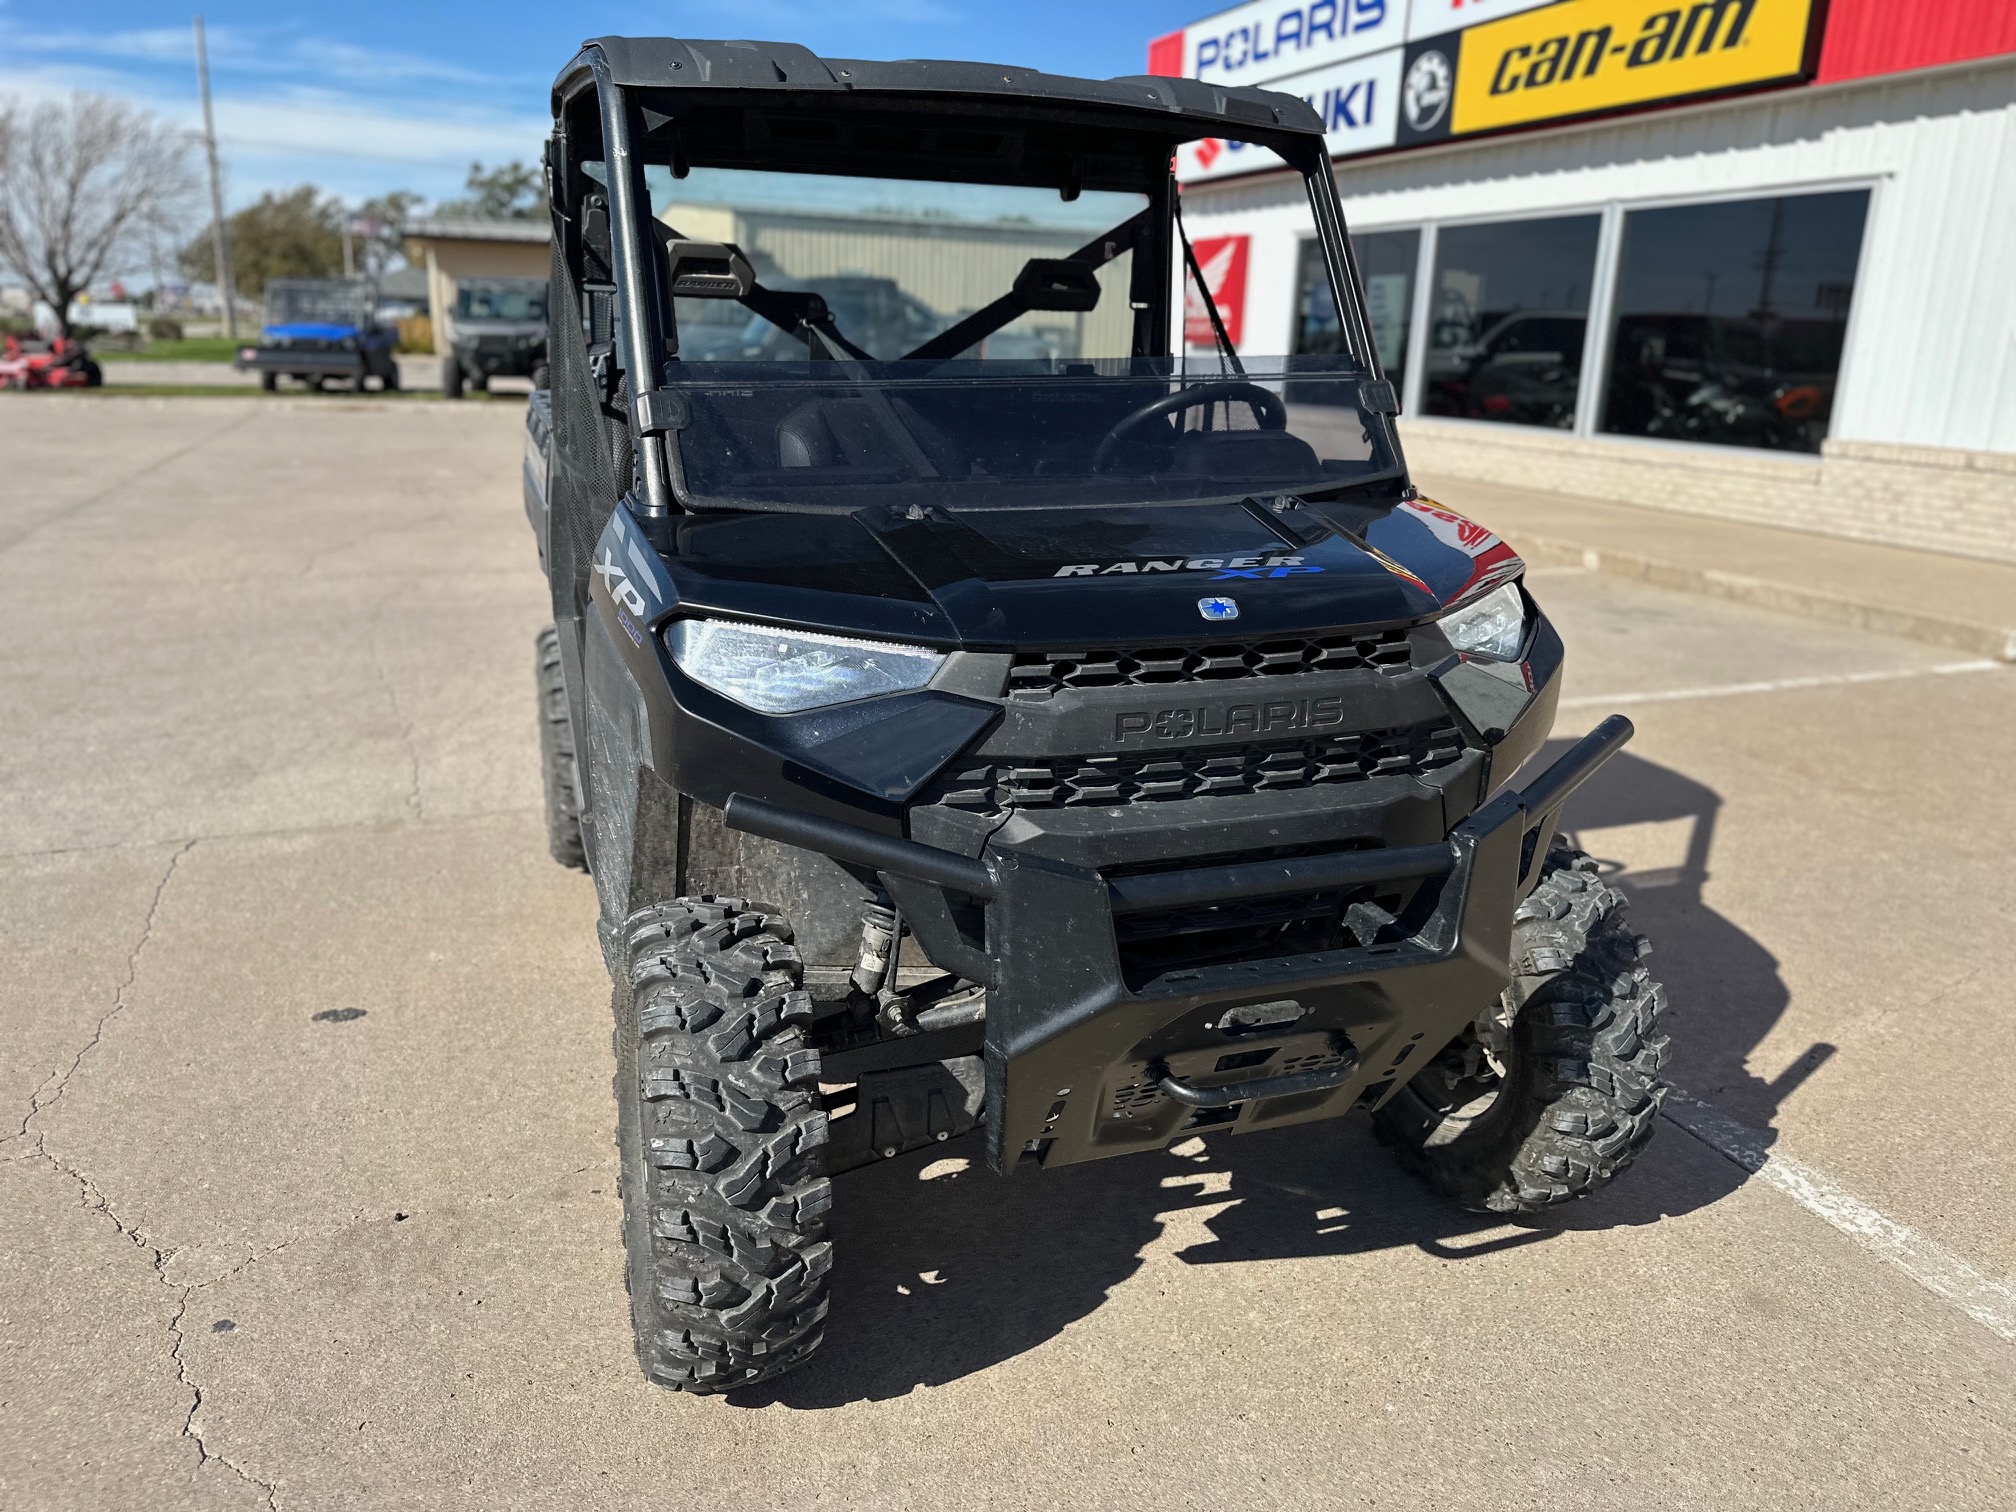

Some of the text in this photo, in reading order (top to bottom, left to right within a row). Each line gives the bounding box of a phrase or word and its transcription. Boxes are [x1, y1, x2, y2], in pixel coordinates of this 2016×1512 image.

[1196, 0, 1387, 79] POLARIS
[593, 546, 646, 617] XP
[1052, 556, 1305, 578] RANGER
[1208, 566, 1326, 580] XP
[1115, 696, 1344, 743] POLARIS
